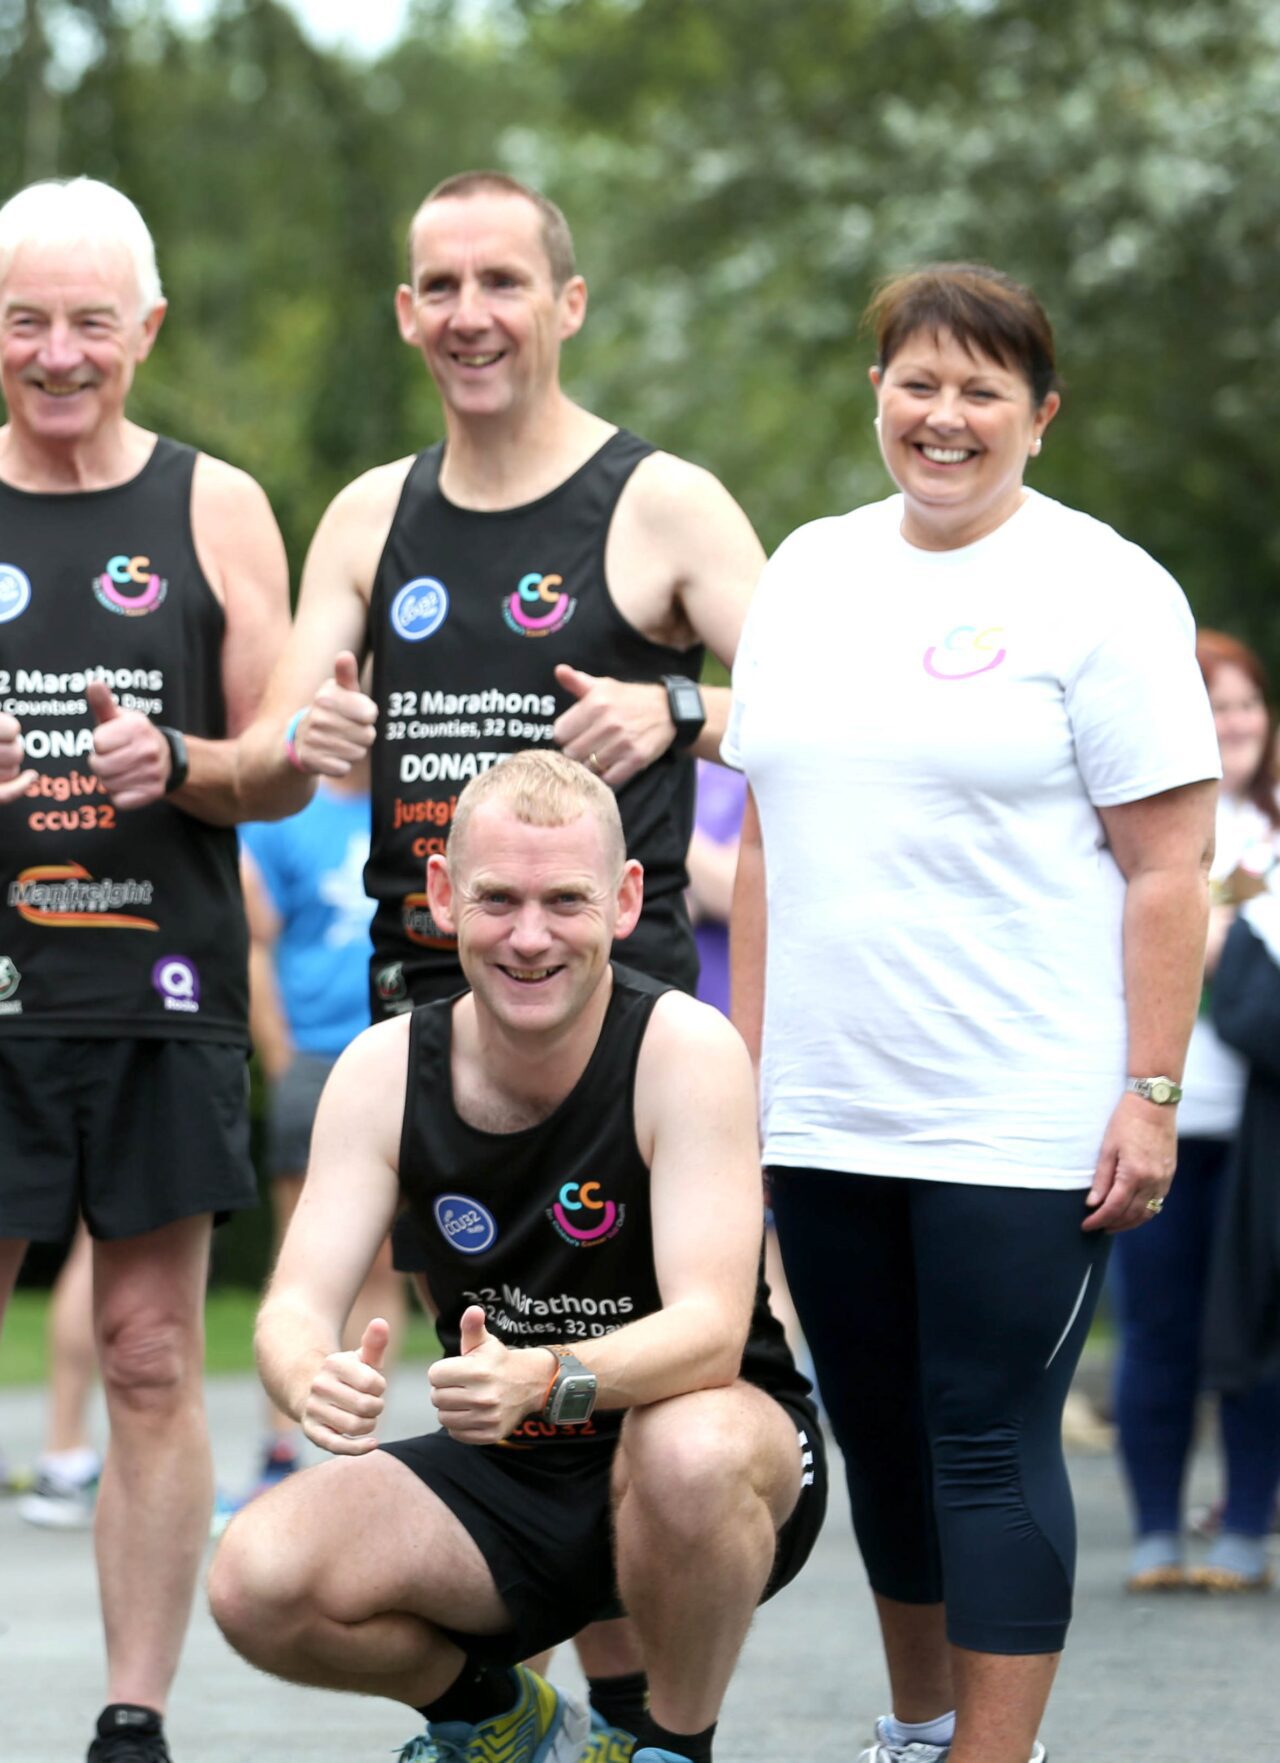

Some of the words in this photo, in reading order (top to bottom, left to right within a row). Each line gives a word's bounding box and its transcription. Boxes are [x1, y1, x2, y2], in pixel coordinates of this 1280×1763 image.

[15, 665, 163, 694] Marathons
[3, 698, 88, 716] Counties
[120, 693, 163, 716] Days
[387, 690, 418, 717] 32
[421, 687, 556, 716] Marathons
[385, 721, 407, 741] 32
[407, 719, 481, 740] Counties,
[483, 718, 506, 737] 32
[507, 718, 556, 742] Days
[400, 752, 515, 783] DONAT
[28, 804, 117, 832] ccu32
[160, 961, 194, 998] Q
[564, 1319, 587, 1337] 32
